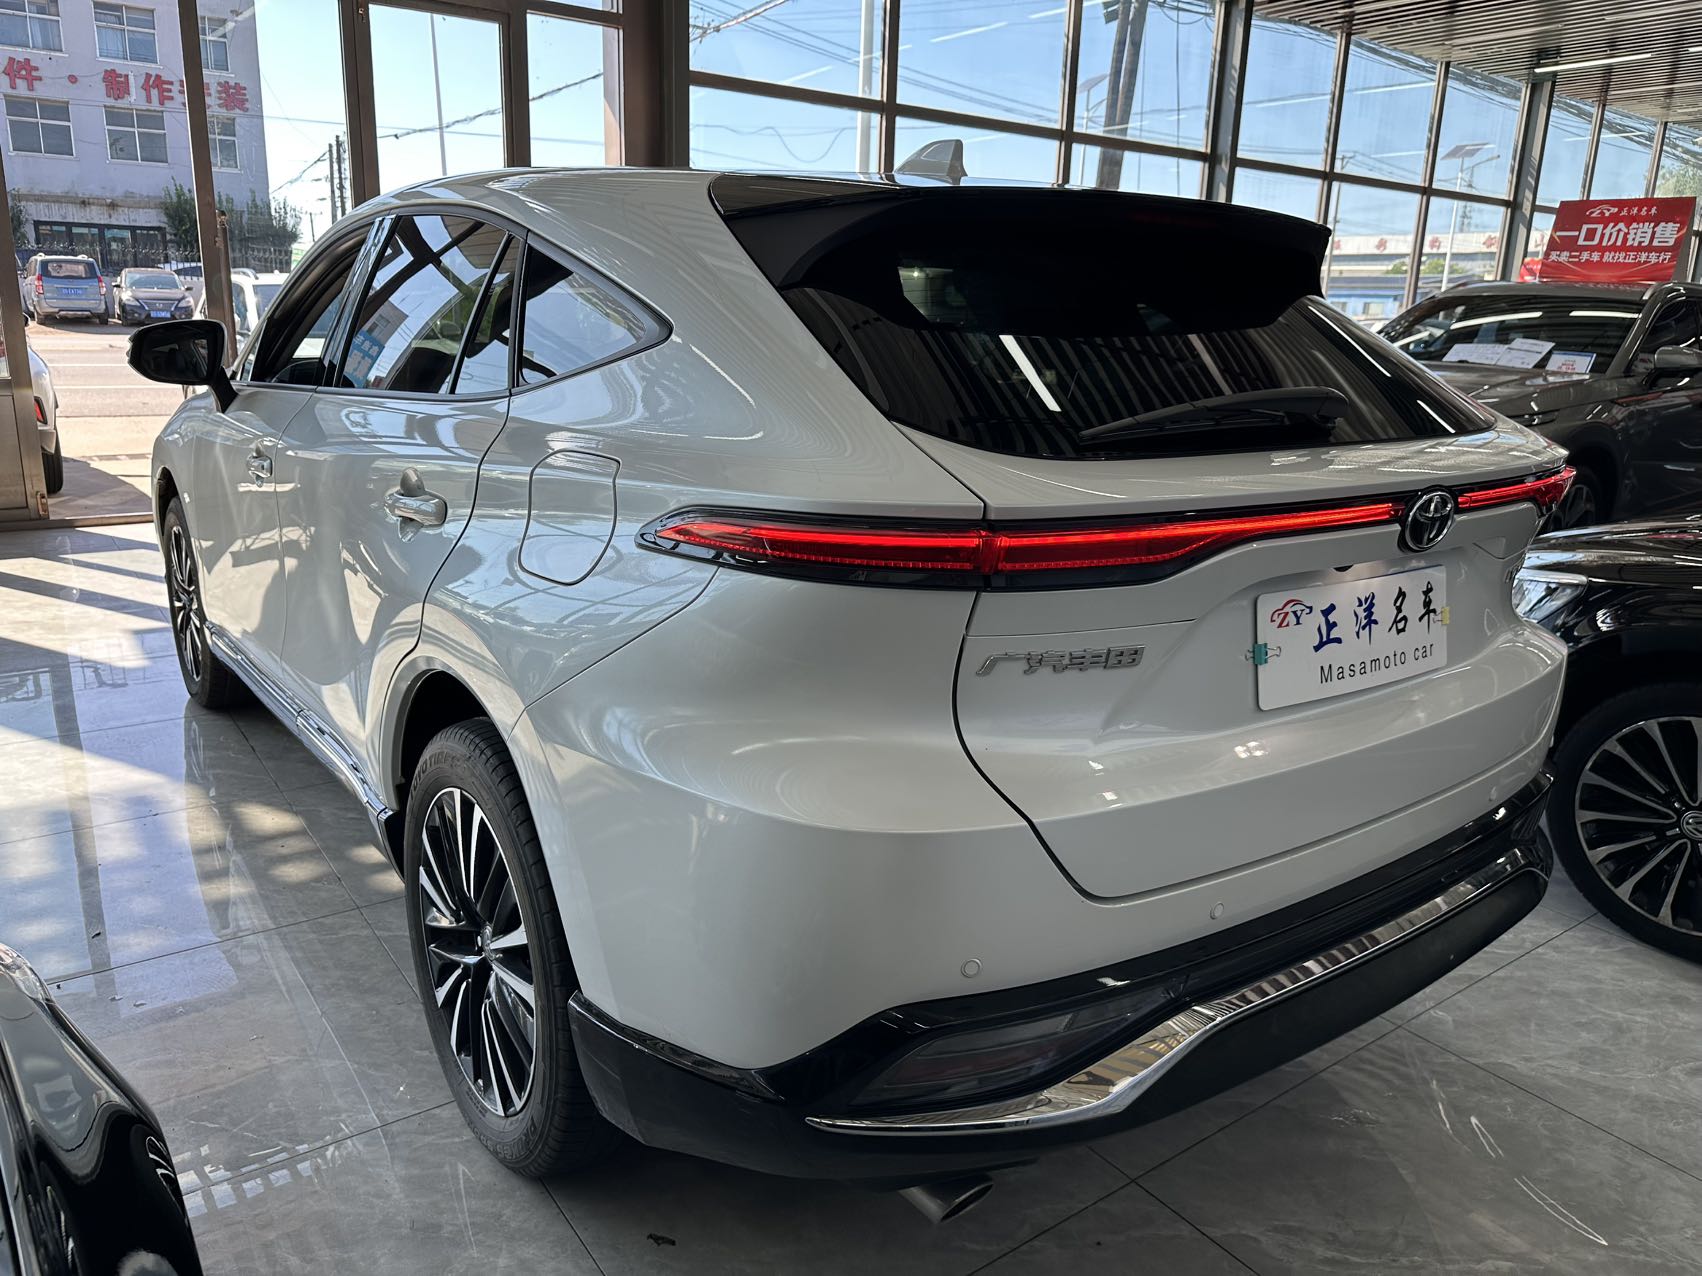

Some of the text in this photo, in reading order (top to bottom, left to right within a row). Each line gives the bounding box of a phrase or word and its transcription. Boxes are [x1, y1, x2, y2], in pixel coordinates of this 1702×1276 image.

[1620, 206, 1658, 217] 正洋名车
[1556, 222, 1681, 247] 一口价销售
[1548, 251, 1673, 264] 买卖二手车 就找正洋车行
[1313, 581, 1438, 653] 正洋名车
[1319, 643, 1435, 684] Masamoto car
